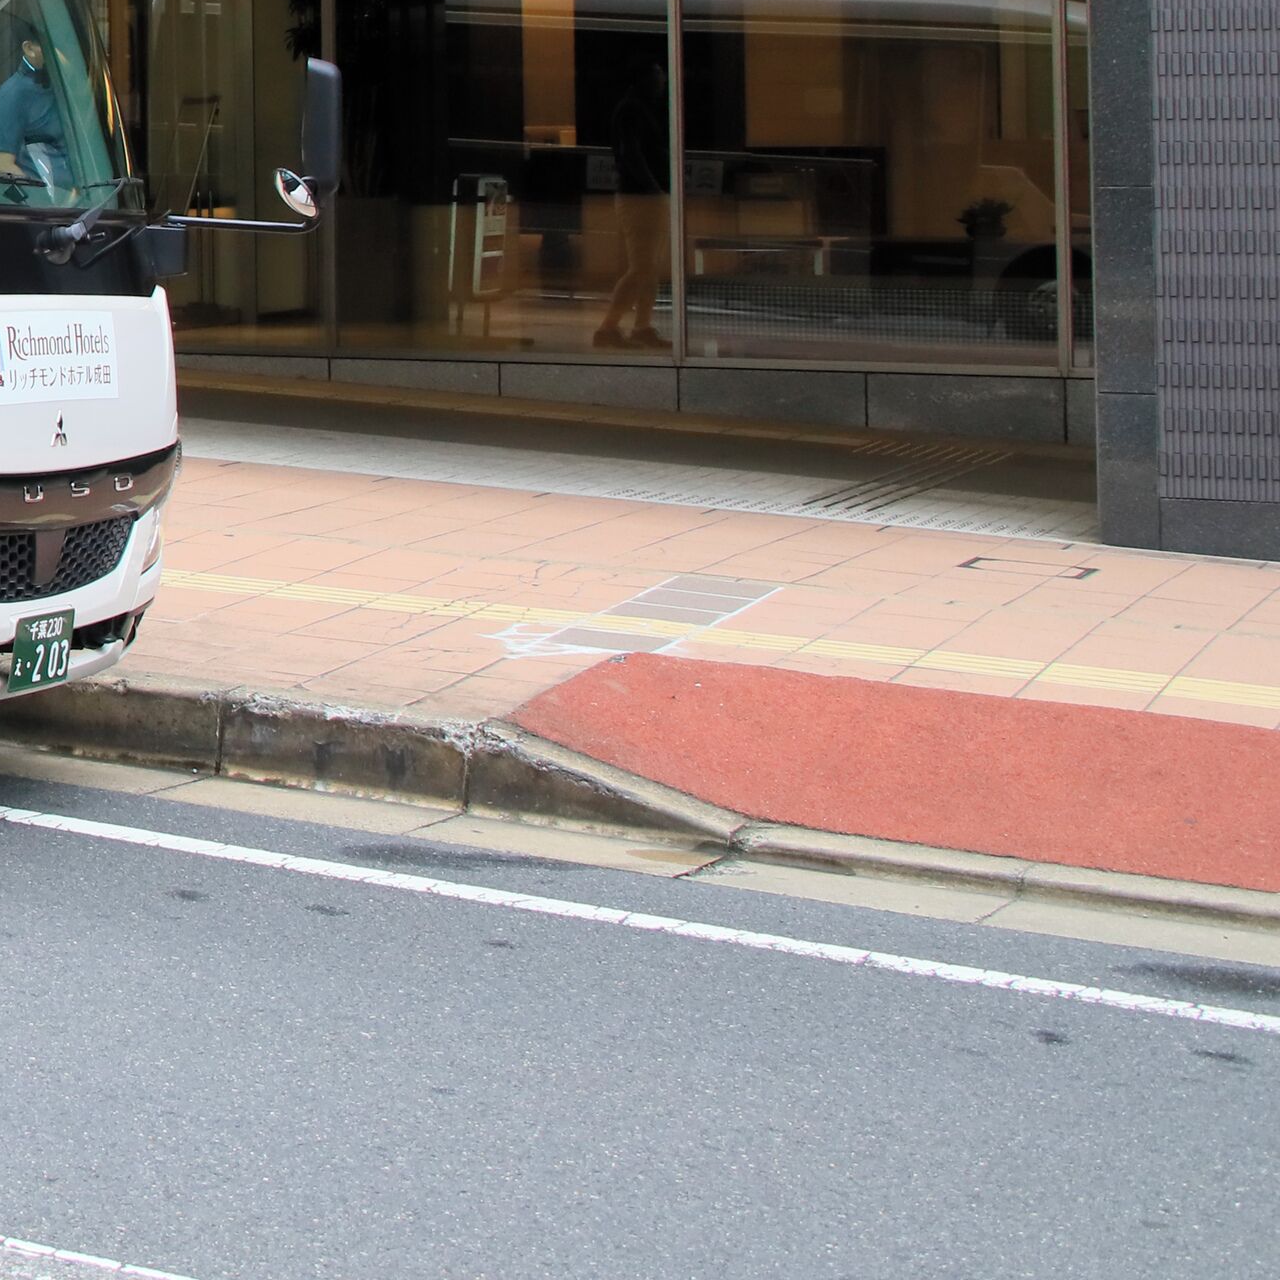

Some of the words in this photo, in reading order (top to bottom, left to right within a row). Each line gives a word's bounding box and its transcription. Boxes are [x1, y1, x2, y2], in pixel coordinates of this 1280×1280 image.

[6, 323, 73, 361] Richmond
[73, 322, 110, 356] Hotels
[9, 364, 112, 392] リッチモンドホテル成田
